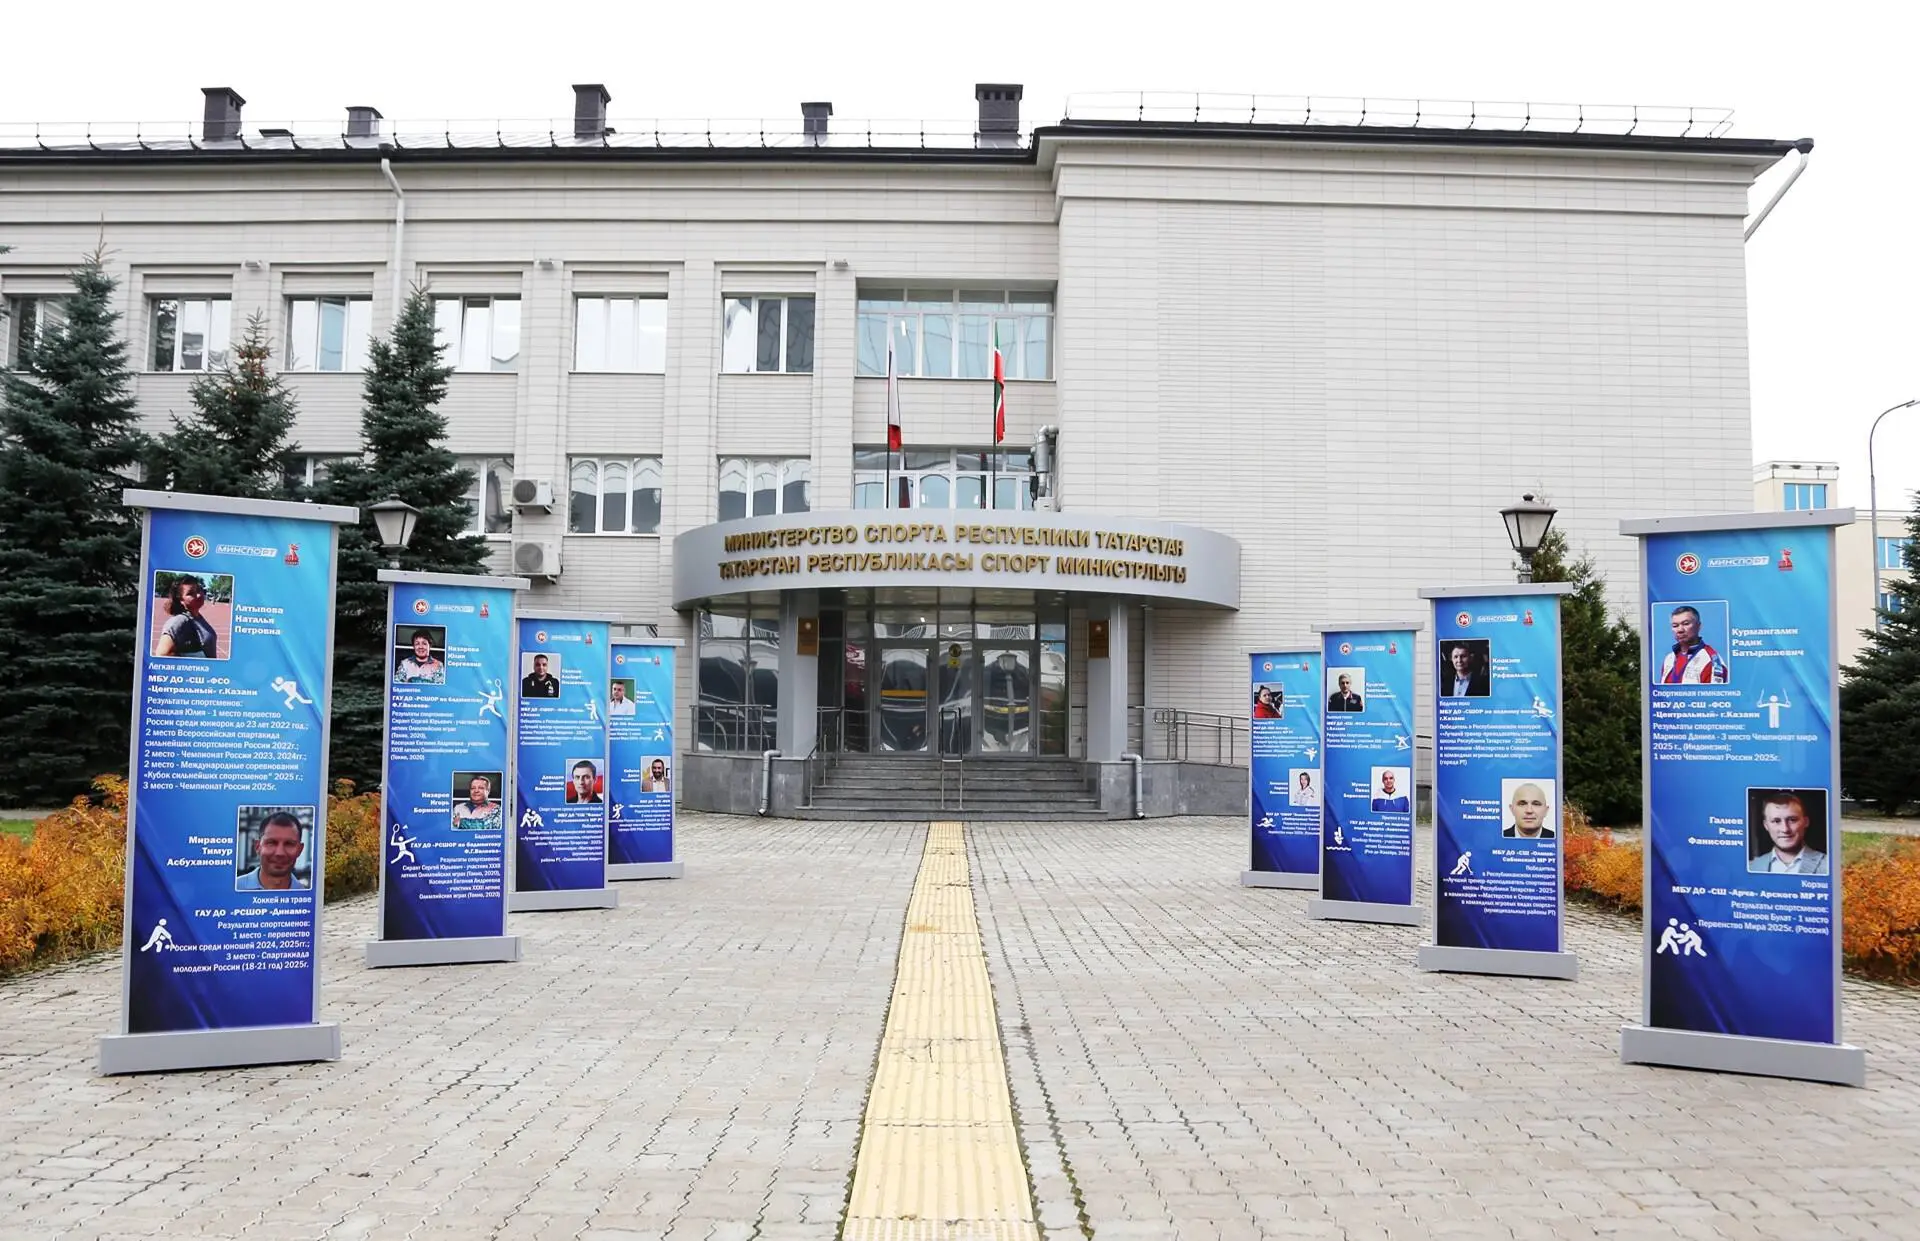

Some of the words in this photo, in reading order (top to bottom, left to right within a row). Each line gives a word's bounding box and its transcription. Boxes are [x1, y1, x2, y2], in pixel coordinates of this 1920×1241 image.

[724, 527, 858, 553] МИНИСТЕРСТВО
[864, 524, 947, 543] СПОРТА
[955, 525, 1091, 549] РЕСПУБЛИКИ
[1096, 531, 1184, 557] ТАТАРСТАН
[718, 555, 800, 580] ТАТАРСТАН
[806, 552, 973, 573] РЕСПУБЛИКАСЫ
[981, 553, 1050, 573] СПОРТ
[1057, 556, 1187, 583] МИНИСТРЛЫГЫ
[235, 605, 284, 614] Латыпова
[235, 615, 275, 624] Наталья
[234, 626, 281, 637] Петровна
[169, 676, 183, 684] ДО
[218, 688, 258, 696] г.Казани
[147, 697, 189, 706] Результаты
[146, 708, 183, 716] Сохацкая
[199, 721, 234, 729] юниорок
[270, 721, 290, 729] 2022
[177, 730, 235, 739] Всероссийская
[192, 742, 242, 750] спортсменов
[180, 762, 244, 770] Международные
[188, 837, 233, 845] Мирасов
[201, 848, 233, 856] Тимур
[167, 859, 233, 867] Асбуханович
[252, 896, 278, 904] Хоккей
[212, 909, 226, 917] ДО
[217, 921, 258, 930] Результаты
[223, 942, 254, 950] юношей
[256, 942, 278, 950] 2024,
[261, 951, 309, 960] Спартакиада
[213, 963, 240, 971] России
[268, 962, 283, 971] год)
[284, 961, 309, 969] 2025г.
